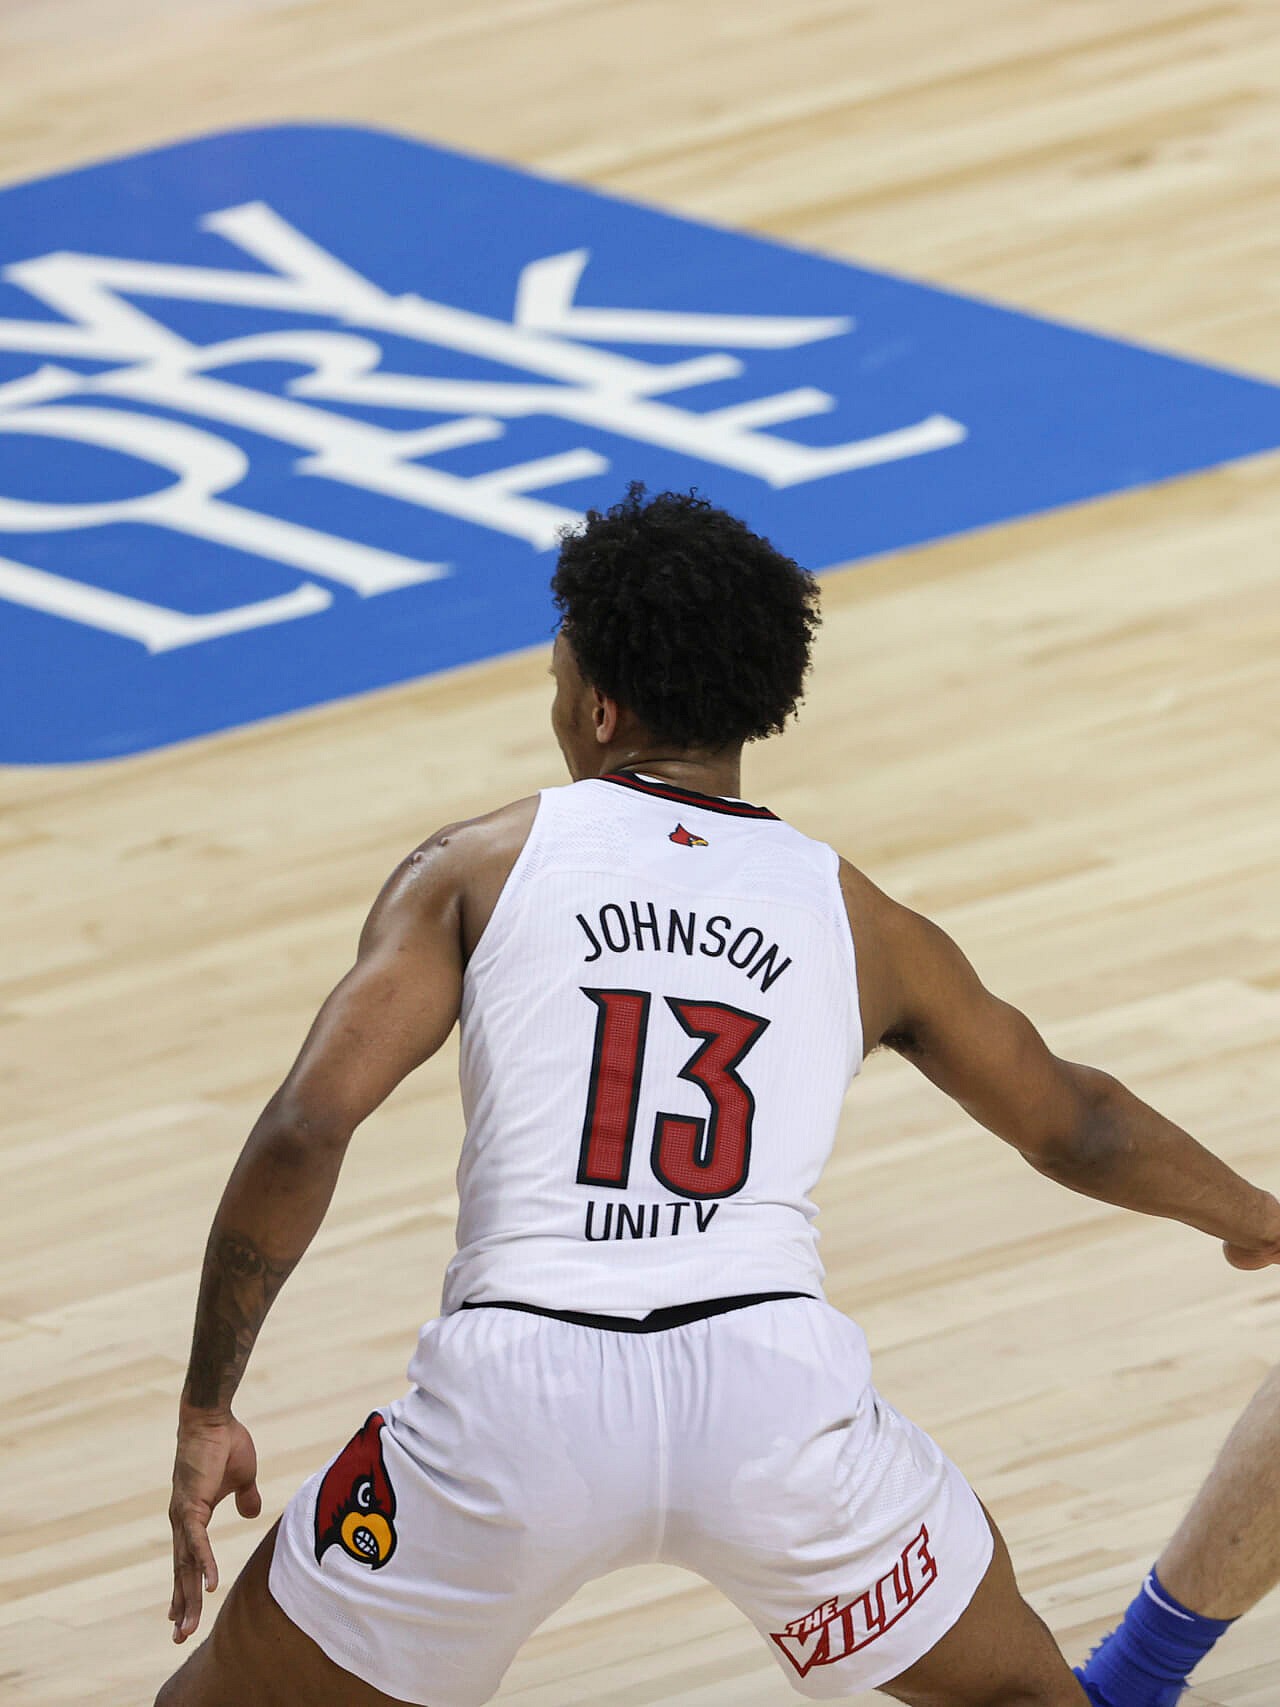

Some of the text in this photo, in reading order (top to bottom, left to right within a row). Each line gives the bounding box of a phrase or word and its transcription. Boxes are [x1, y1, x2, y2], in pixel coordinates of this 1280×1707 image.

[0, 247, 855, 532] ORK
[576, 901, 792, 993] JOHNSON
[576, 986, 771, 1200] 13
[585, 1201, 719, 1241] UNITY
[769, 1522, 938, 1679] VILLE
[785, 1595, 840, 1636] THE
